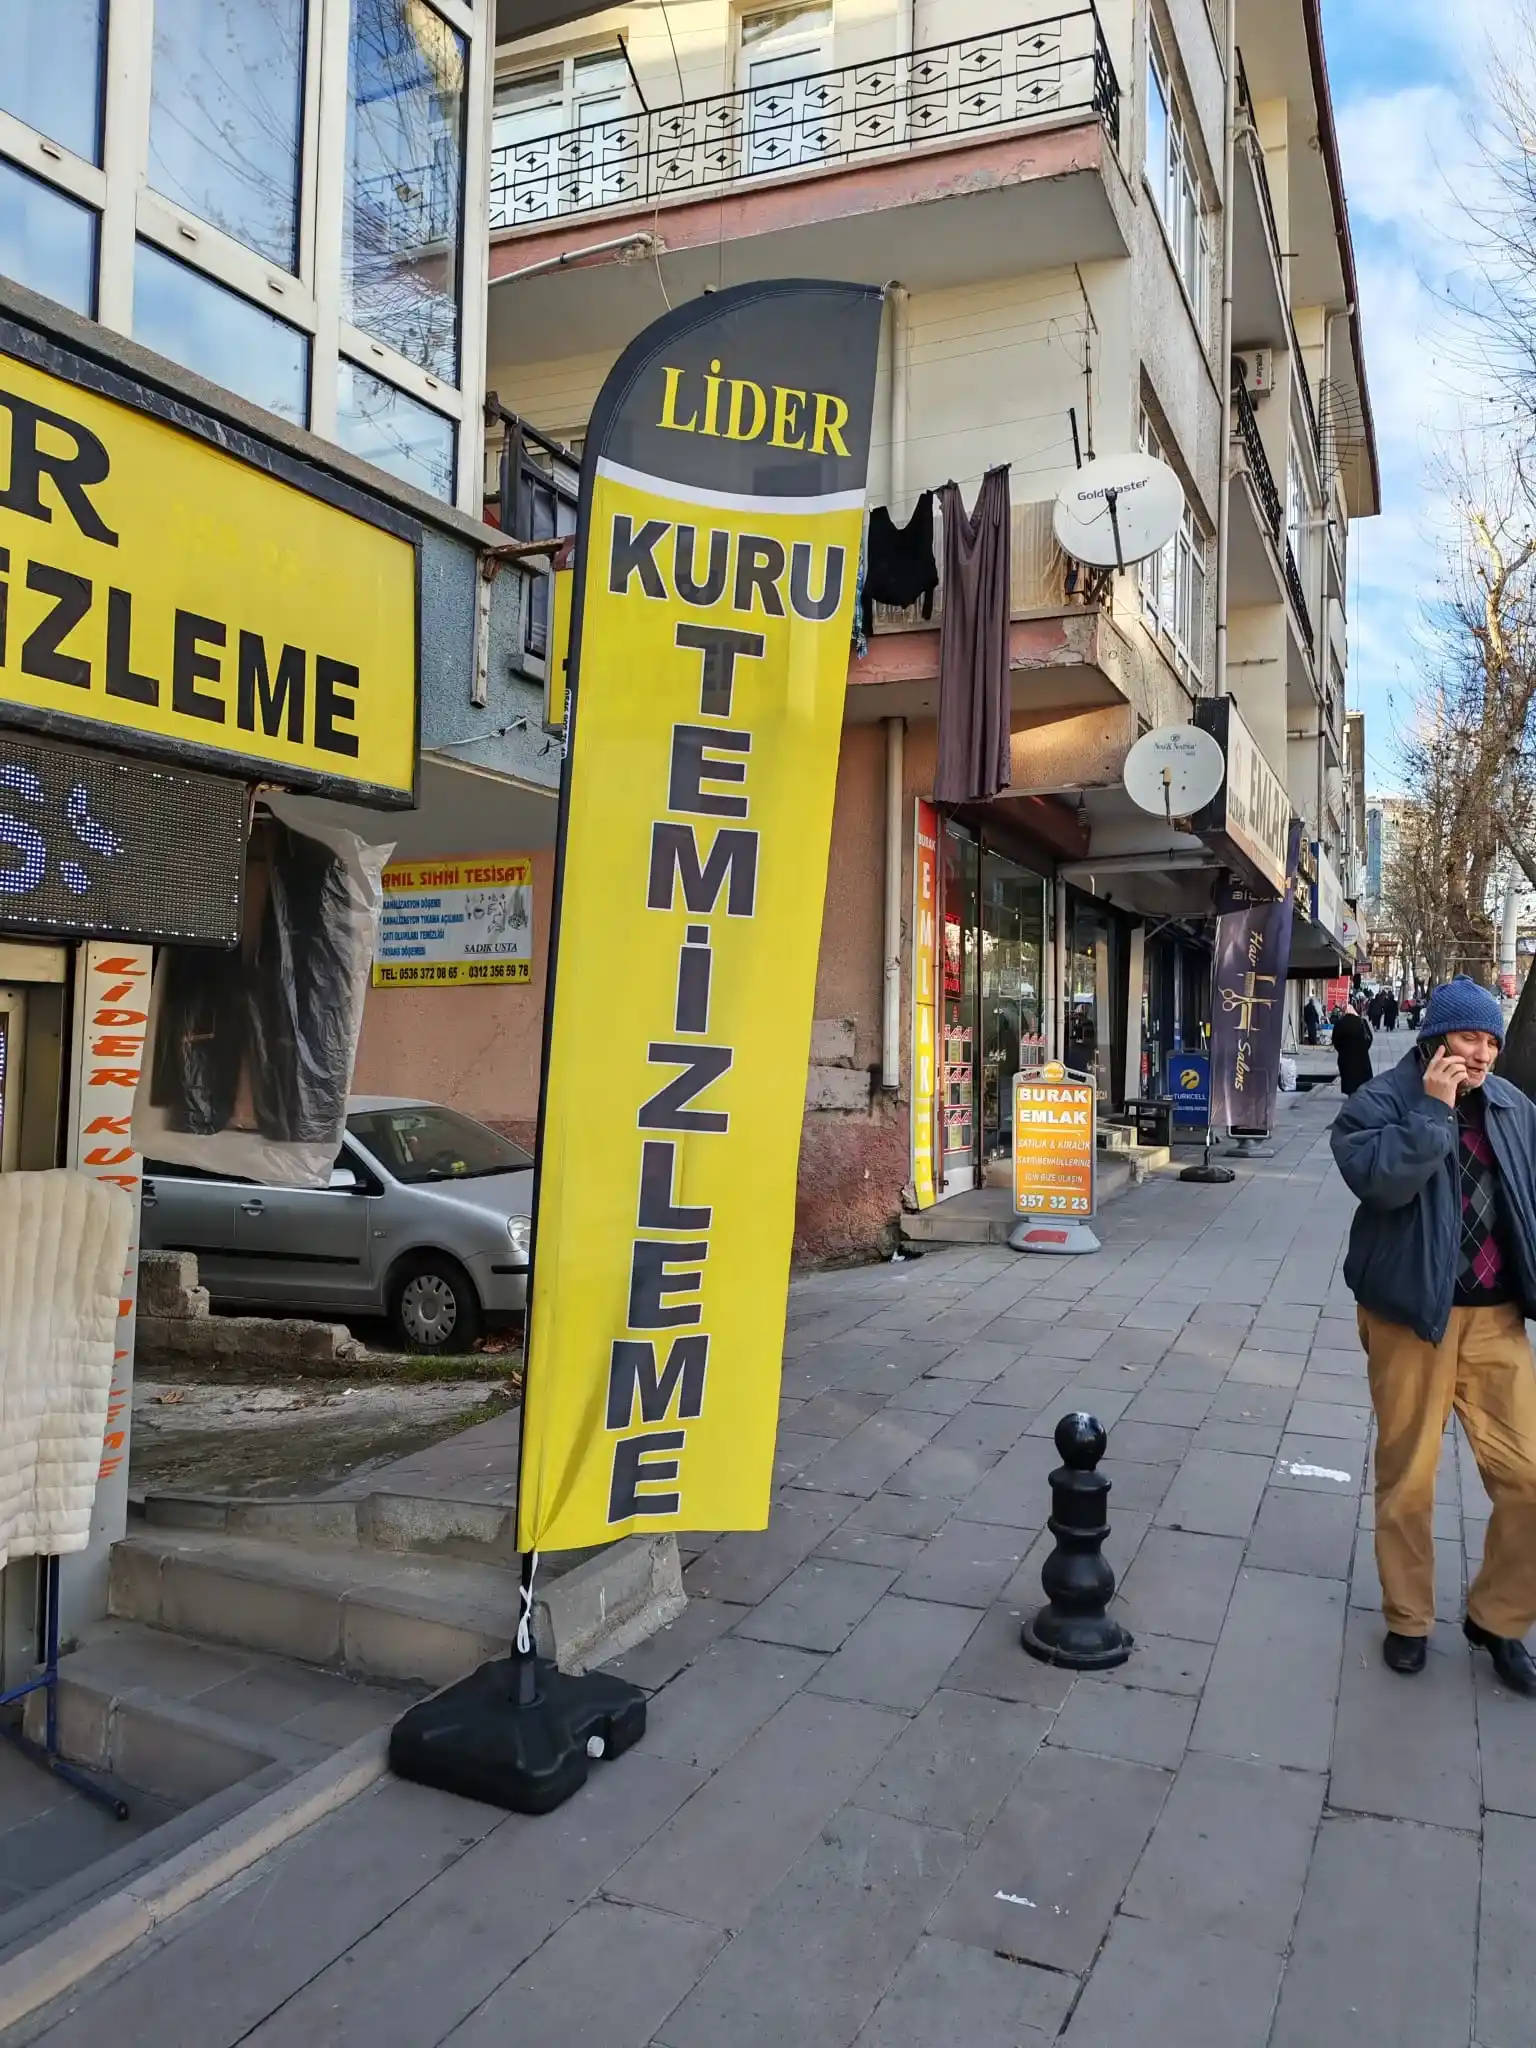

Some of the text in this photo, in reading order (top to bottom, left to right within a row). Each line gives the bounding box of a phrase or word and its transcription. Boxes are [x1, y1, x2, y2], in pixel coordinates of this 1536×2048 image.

[656, 359, 851, 457] LİDER
[608, 515, 847, 622] KURU
[1250, 748, 1290, 863] EMLAK
[464, 865, 525, 883] TESİSAT
[464, 943, 518, 954] SADIK USTA
[1248, 930, 1264, 968] Hair
[381, 968, 397, 980] TEL:
[399, 968, 418, 980] 0536
[420, 968, 434, 979] 372
[436, 967, 446, 979] 08
[448, 967, 458, 979] 65
[469, 966, 487, 978] 0312
[489, 965, 504, 977] 356
[506, 965, 516, 976] 59
[518, 964, 528, 976] 78
[919, 861, 932, 1093] EMLAK
[88, 957, 148, 1087] LİDER
[605, 623, 766, 1525] TEMİZLEME
[1234, 1039, 1252, 1092] Salons
[1019, 1088, 1088, 1103] BURAK
[1019, 1109, 1088, 1125] EMLAK
[1017, 1139, 1047, 1149] SATILIK
[1049, 1140, 1056, 1149] &
[1019, 1194, 1089, 1210] 357 32 23
